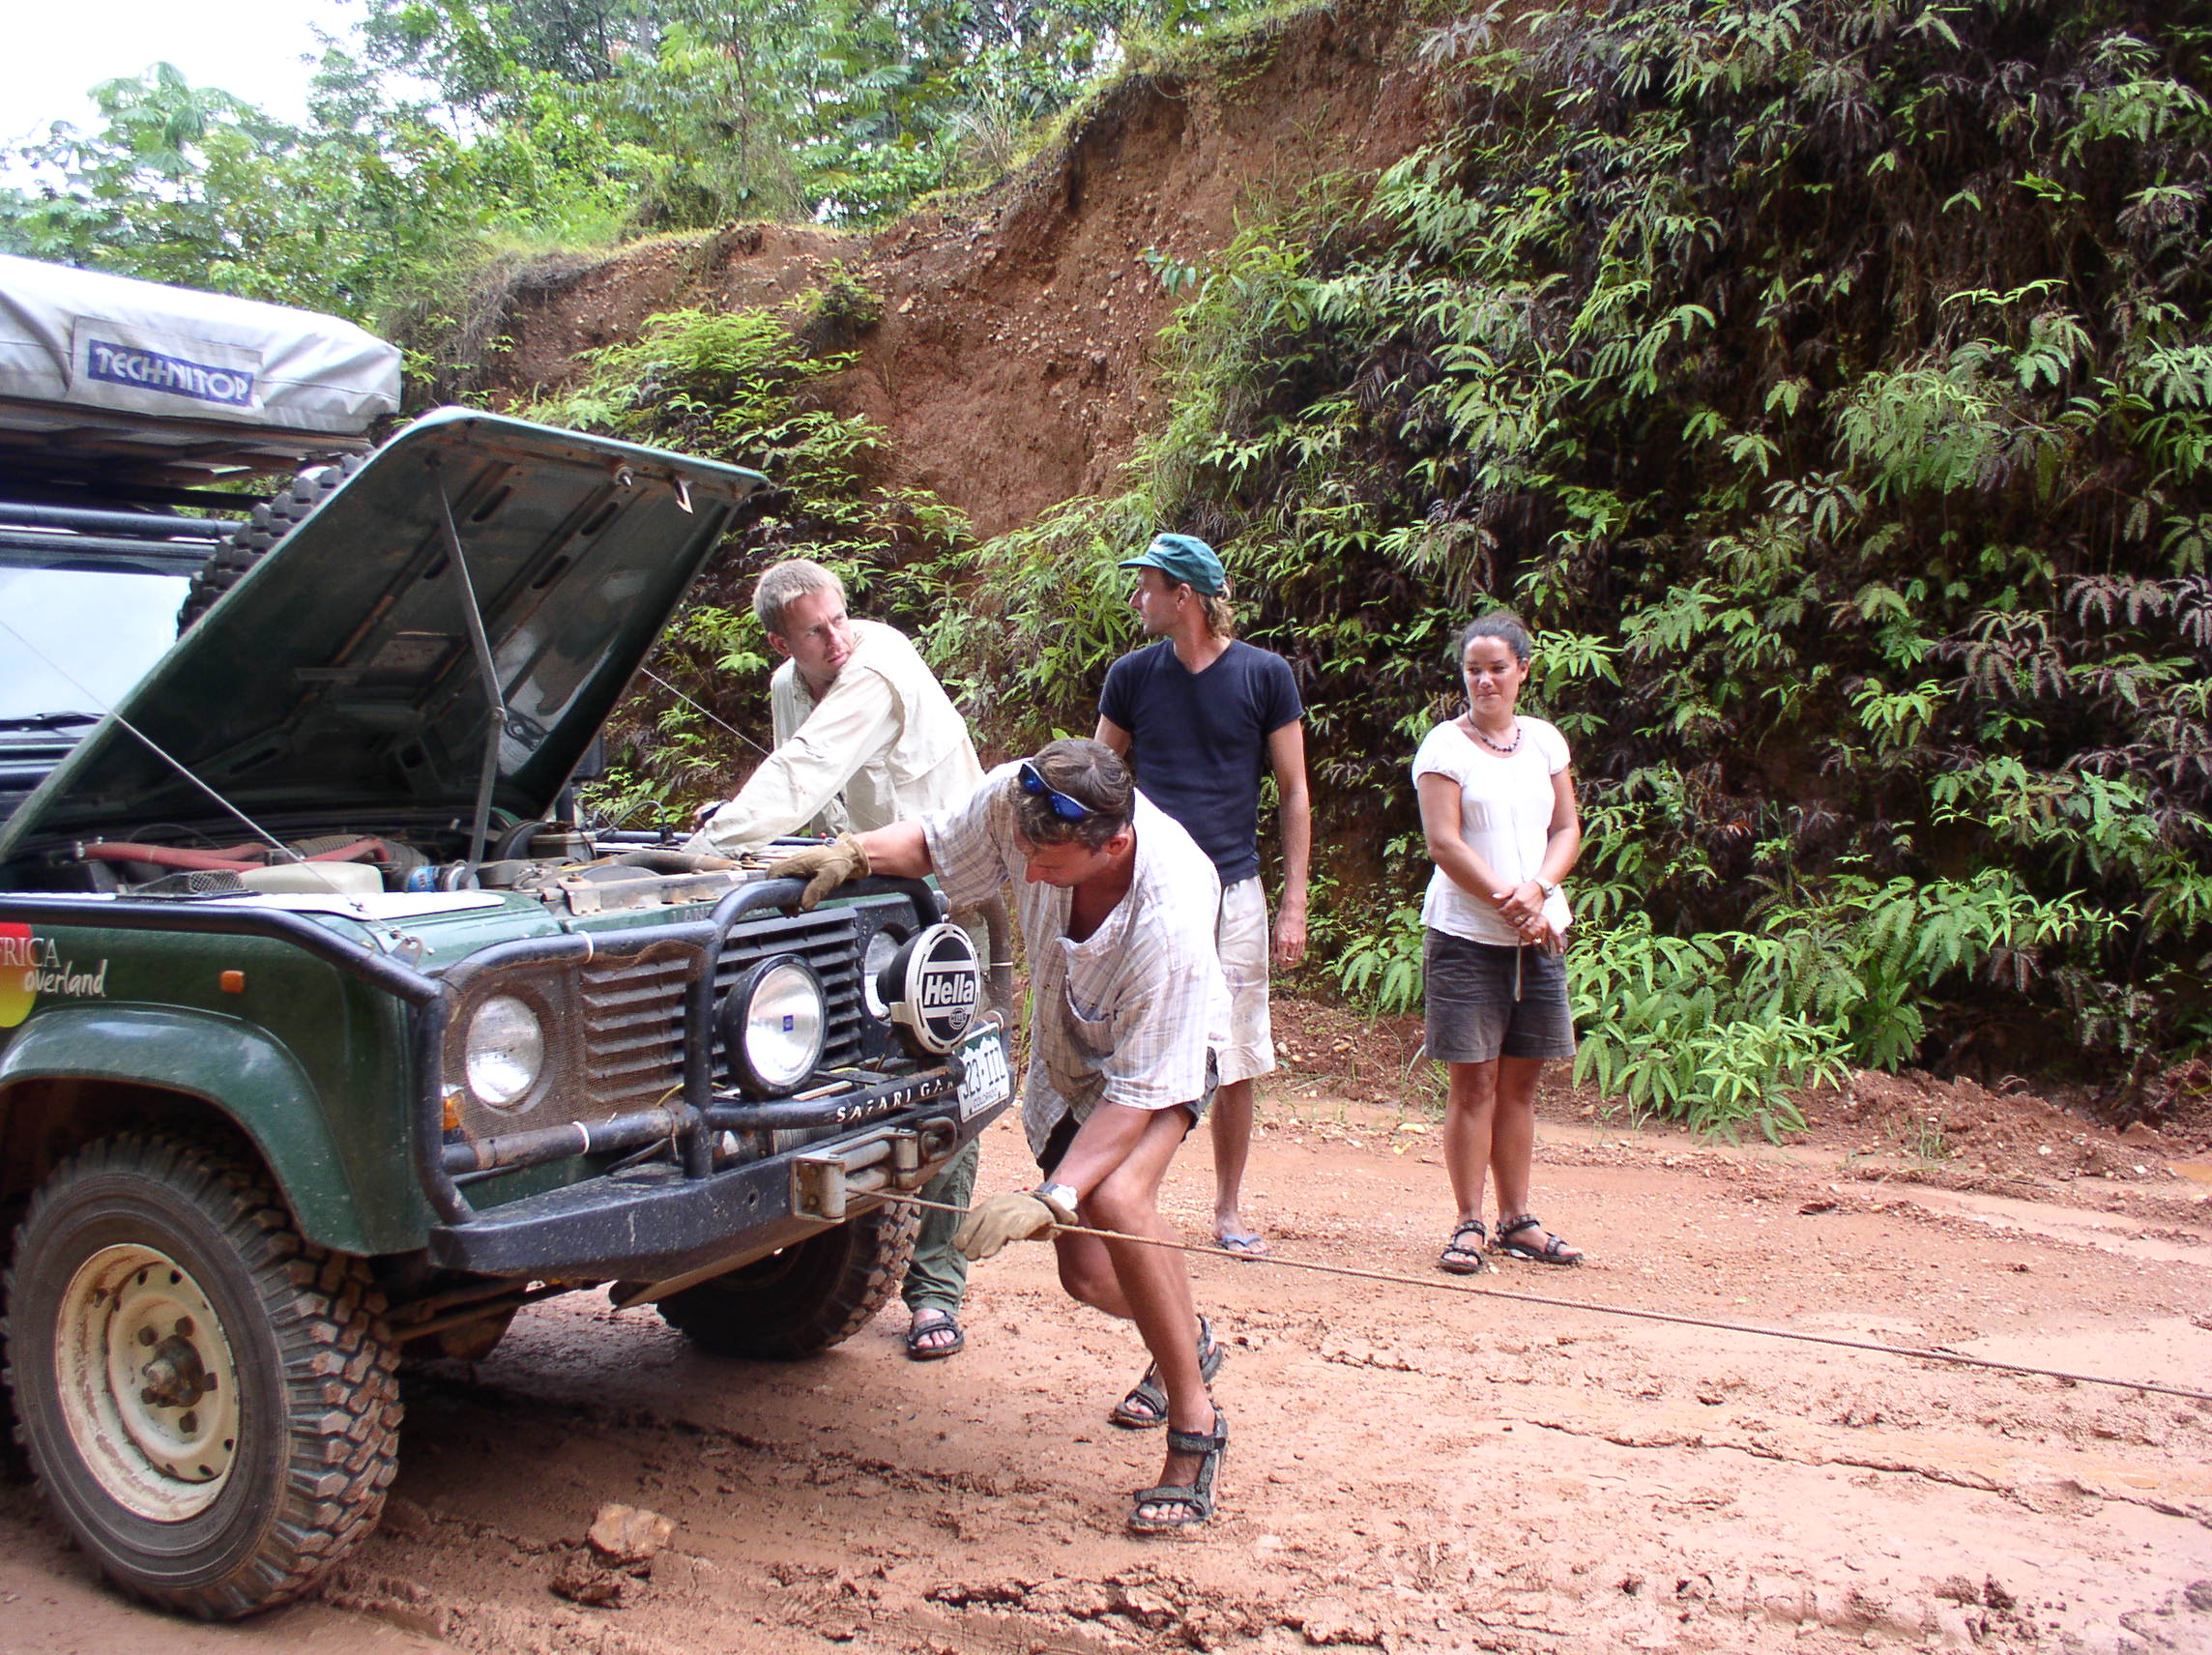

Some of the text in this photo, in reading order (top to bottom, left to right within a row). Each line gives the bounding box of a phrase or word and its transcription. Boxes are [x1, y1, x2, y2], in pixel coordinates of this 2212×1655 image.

[95, 346, 248, 399] TECHNITOP
[24, 959, 108, 997] overland
[923, 973, 975, 1004] Hella
[836, 1088, 912, 1122] SAFARI
